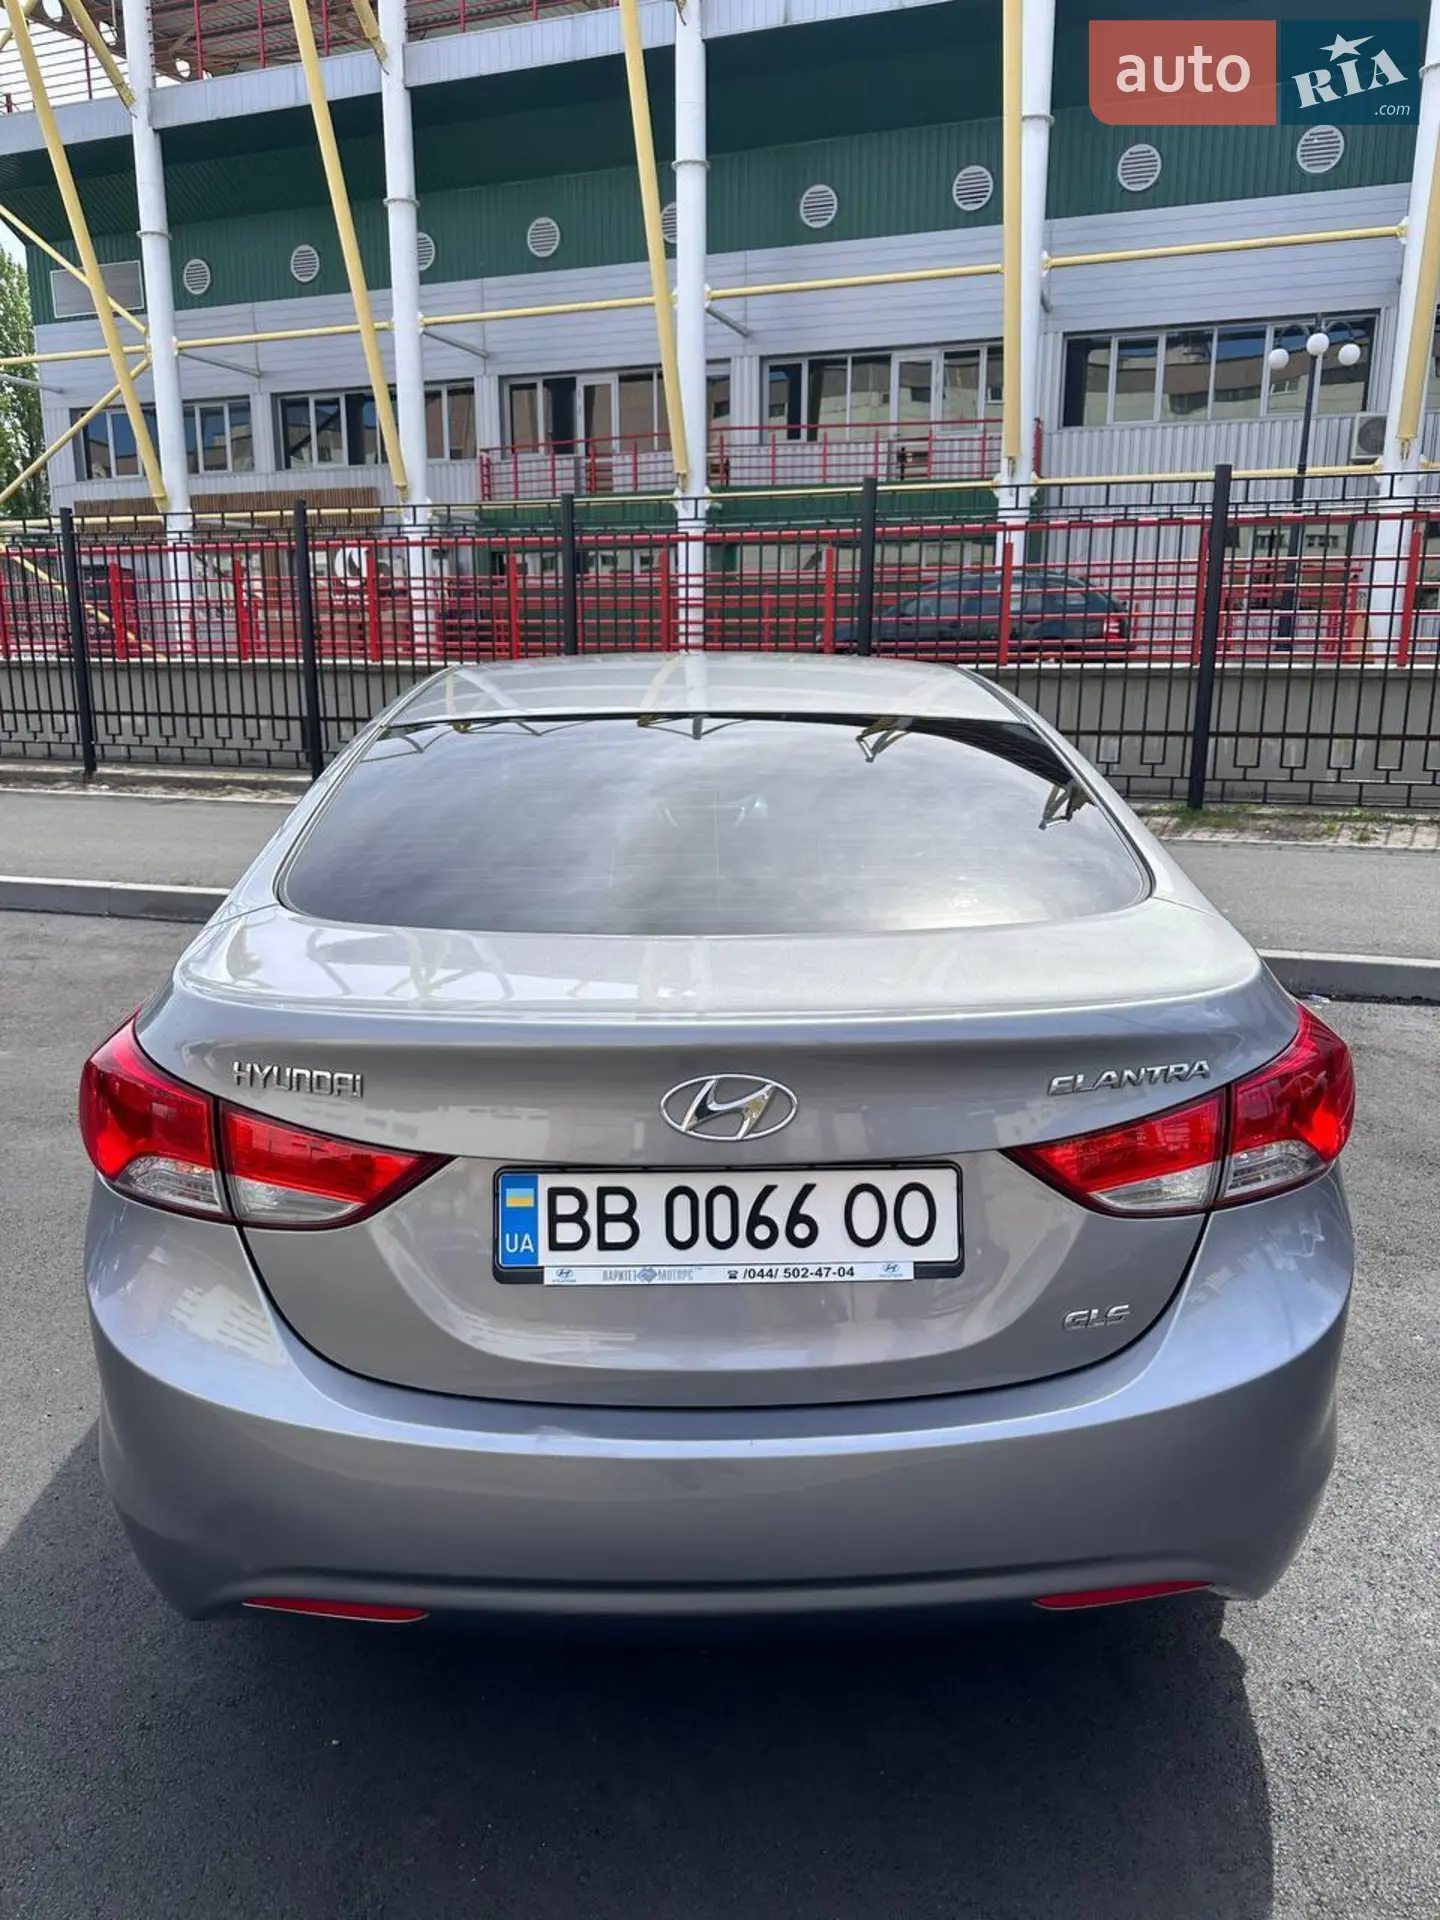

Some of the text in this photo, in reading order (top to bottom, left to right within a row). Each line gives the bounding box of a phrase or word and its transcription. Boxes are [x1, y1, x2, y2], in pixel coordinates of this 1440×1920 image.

[232, 1060, 364, 1098] HYUNDAI
[1046, 1059, 1212, 1096] ELANTRA
[546, 1186, 641, 1251] BB
[664, 1182, 819, 1251] 0066
[505, 1232, 535, 1253] UA
[743, 1266, 856, 1280] /044/ 502-47-04
[1062, 1304, 1131, 1331] GLS
